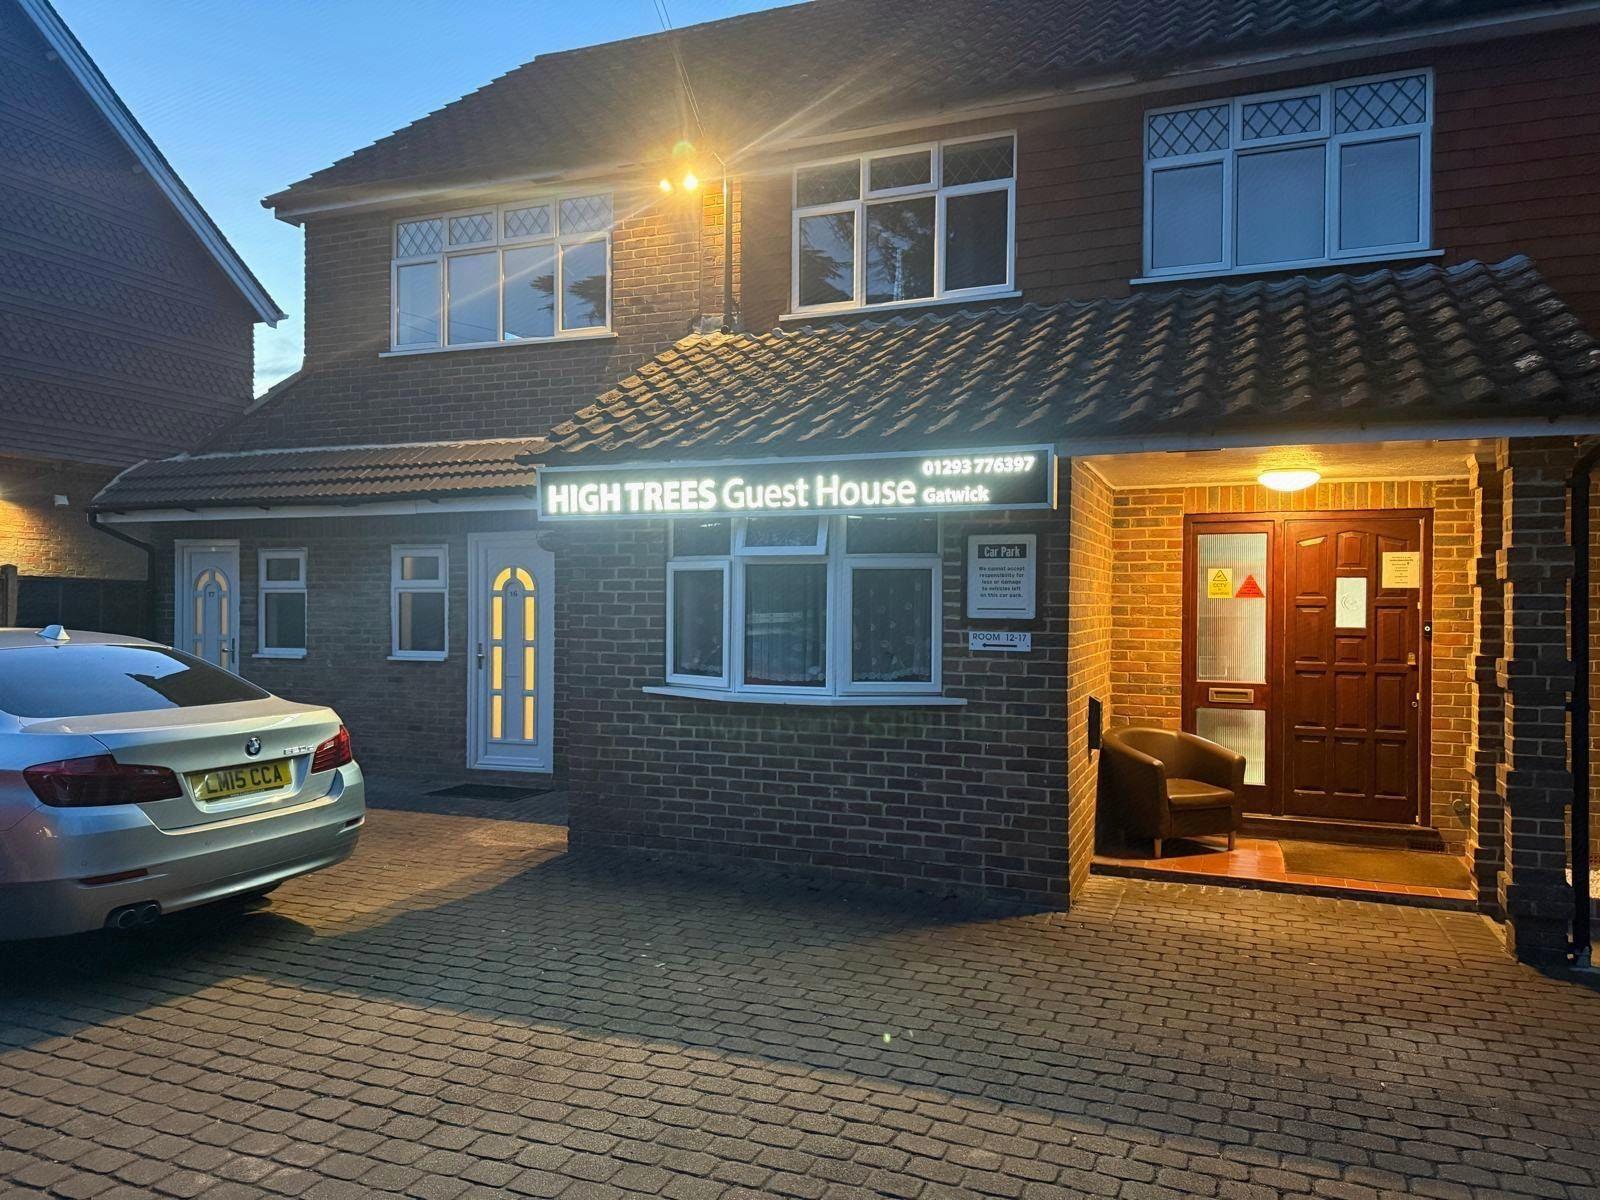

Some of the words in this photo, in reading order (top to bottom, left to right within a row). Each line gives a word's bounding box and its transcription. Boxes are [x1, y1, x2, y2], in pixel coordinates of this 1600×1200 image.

[922, 458, 972, 476] 01293
[973, 454, 1036, 474] 776397
[547, 482, 621, 514] HIGH
[624, 478, 717, 512] TREES
[721, 477, 810, 509] Guest
[815, 474, 917, 506] House
[922, 484, 990, 504] Gatwick
[984, 546, 999, 558] Car
[1000, 546, 1021, 558] Park
[1006, 634, 1027, 642] 12-17
[205, 770, 247, 794] LM15
[250, 765, 283, 786] CCA
